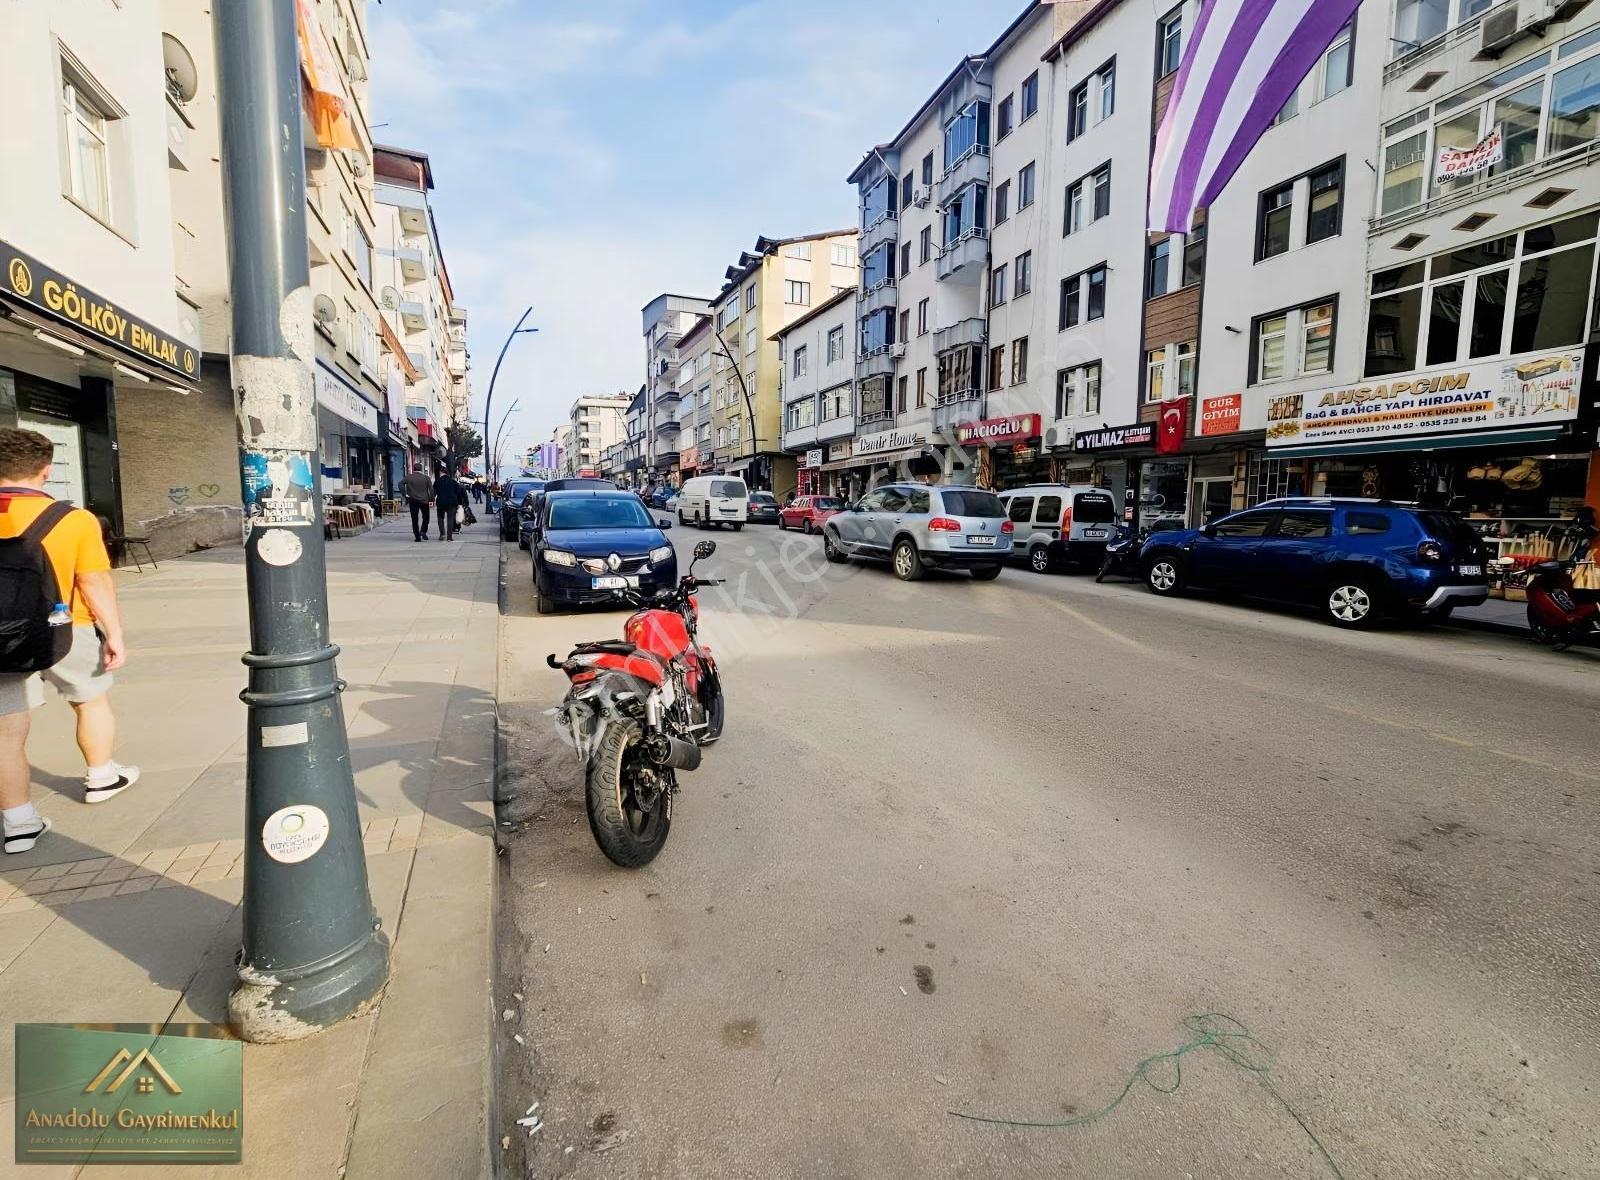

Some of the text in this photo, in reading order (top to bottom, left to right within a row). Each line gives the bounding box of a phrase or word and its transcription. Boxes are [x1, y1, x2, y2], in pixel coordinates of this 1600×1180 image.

[43, 280, 178, 366] GÖLKÖY EMLAK
[1330, 409, 1337, 417] &
[1385, 400, 1414, 410] YAPI
[1419, 390, 1491, 407] HIRDAVAT
[889, 432, 918, 448] Home
[1085, 430, 1124, 448] YILMAZ
